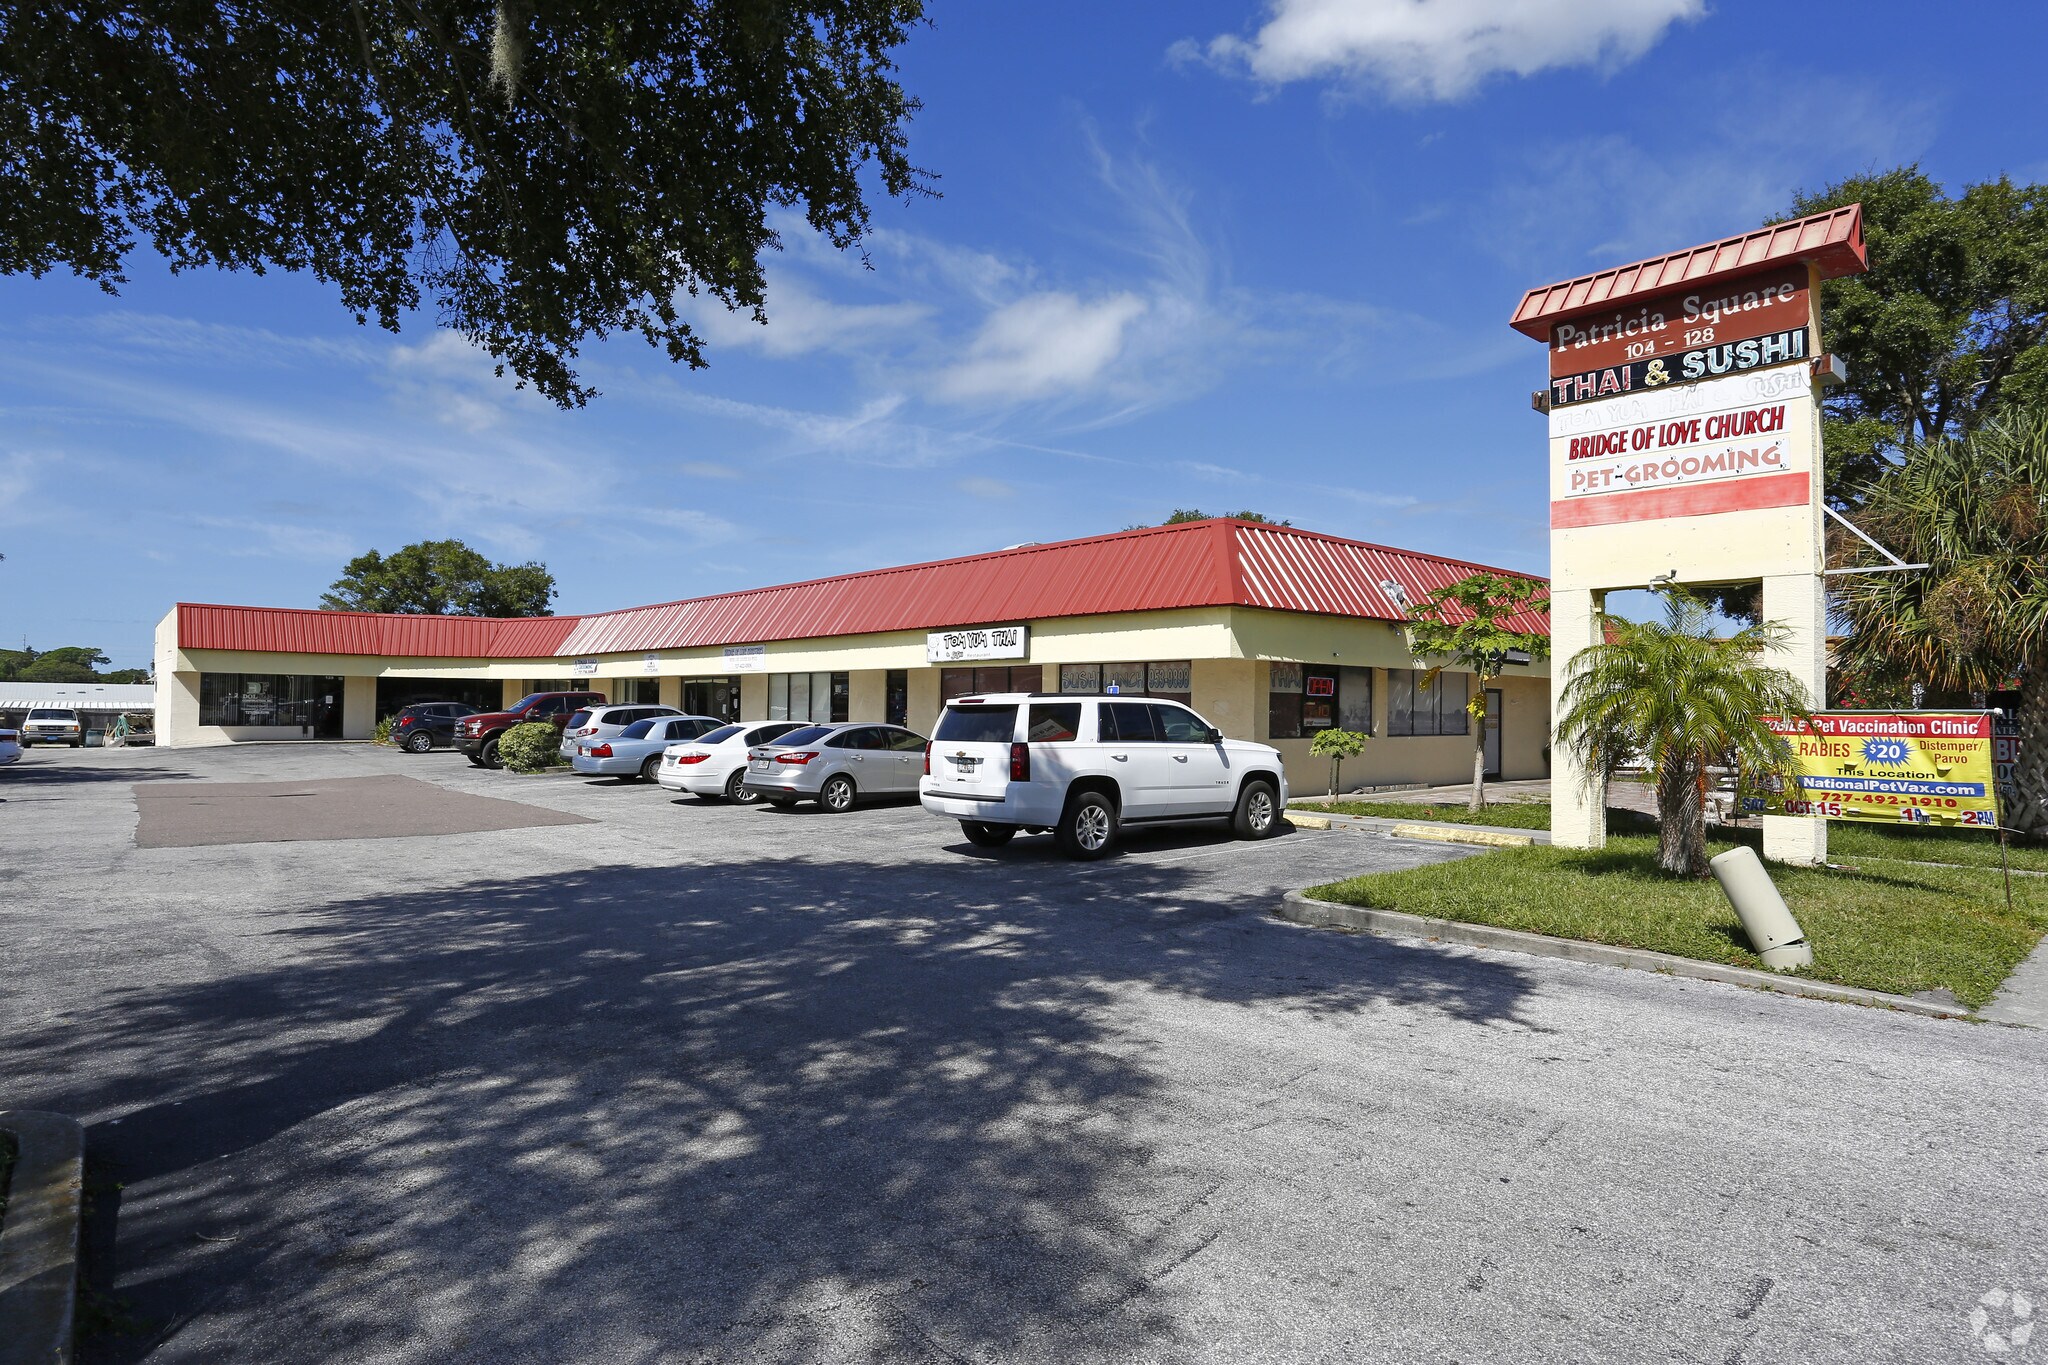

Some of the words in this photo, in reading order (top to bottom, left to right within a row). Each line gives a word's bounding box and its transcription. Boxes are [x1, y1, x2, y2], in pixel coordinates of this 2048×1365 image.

[1557, 308, 1667, 352] Patricia
[1683, 283, 1795, 325] Square
[1624, 340, 1655, 358] 104
[1683, 328, 1715, 346] 128
[1553, 365, 1631, 403] THAI
[1644, 359, 1671, 386] &
[1682, 330, 1803, 379] SUSHI
[1569, 430, 1629, 460] BRIDGE
[1631, 426, 1656, 451] OF
[1658, 418, 1702, 447] LOVE
[1704, 405, 1786, 440] CHURCH
[944, 634, 966, 649] TOM
[967, 632, 987, 648] YUM
[1308, 678, 1333, 695] OPEN
[1812, 719, 1835, 733] Pet
[1839, 719, 1925, 735] Vaccination
[1930, 720, 1979, 735] Clinic
[1799, 742, 1851, 758] RABIES
[1869, 743, 1901, 759] $20
[1919, 740, 1983, 753] Distemper/
[1934, 753, 1968, 764] Parvo
[1836, 768, 1865, 777] This
[1869, 769, 1936, 779] Location
[1803, 777, 1976, 795] NationalPetVax.com
[1820, 792, 1957, 808] 727-492-1910
[1742, 798, 1766, 811] SAT
[1785, 799, 1812, 814] OCT
[1816, 801, 1842, 817] 15
[1962, 810, 1996, 826] 2PM
